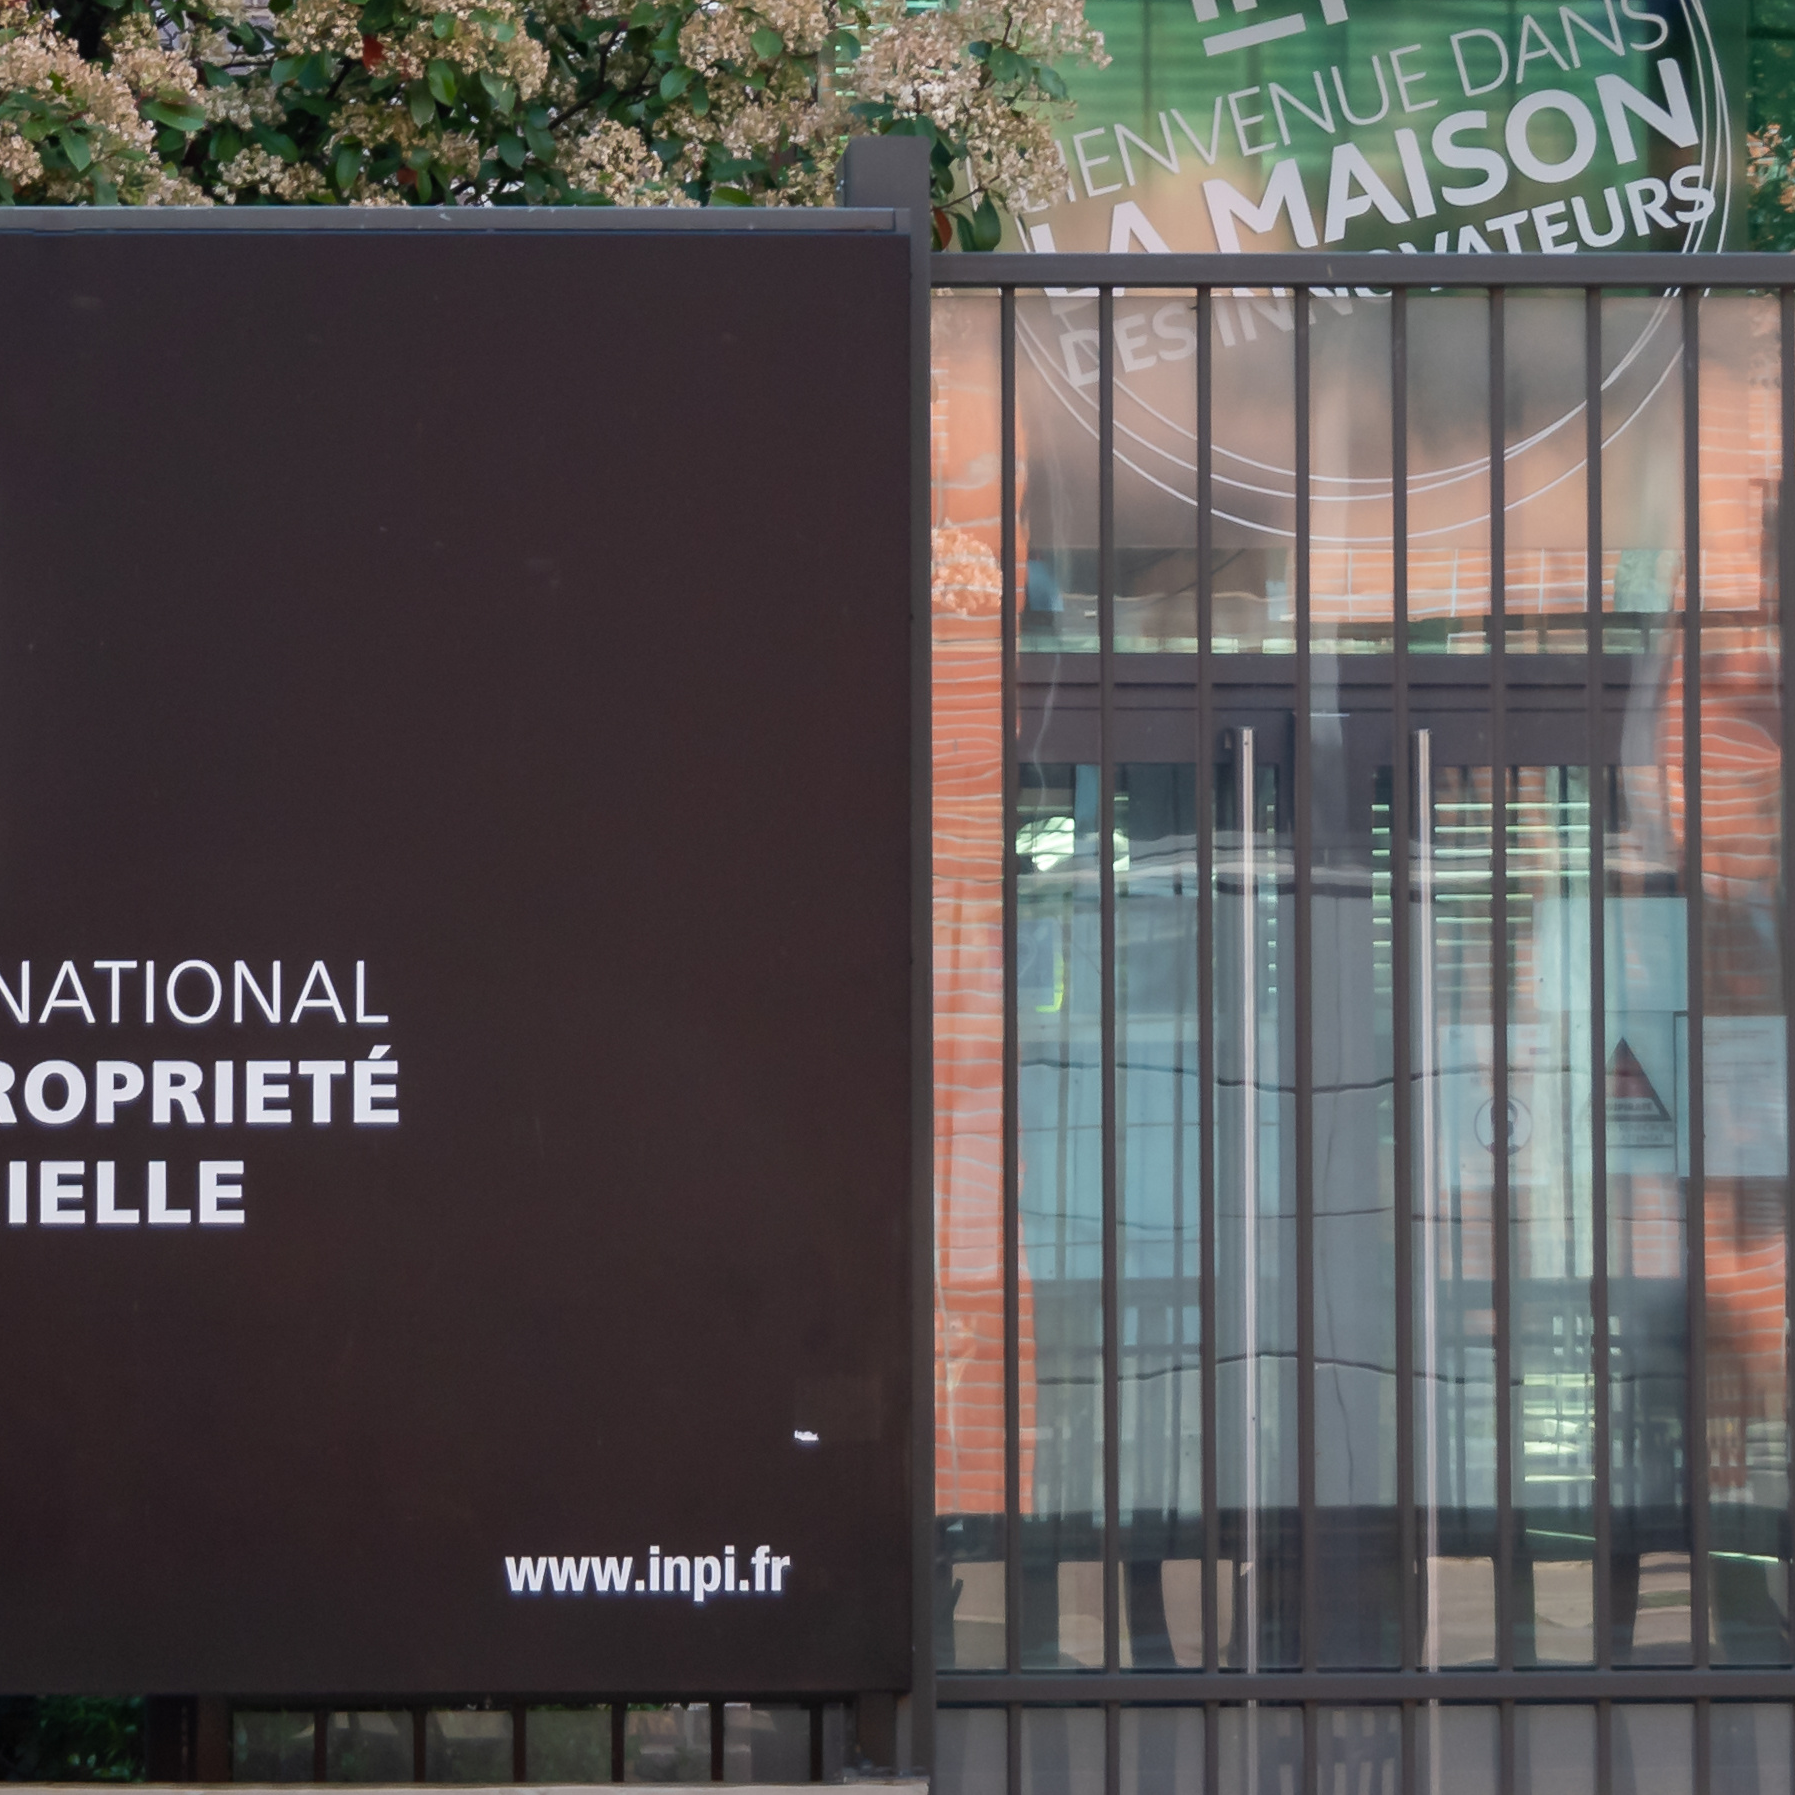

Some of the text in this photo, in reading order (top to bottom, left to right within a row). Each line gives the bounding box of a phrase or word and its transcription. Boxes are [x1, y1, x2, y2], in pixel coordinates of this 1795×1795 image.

[1022, 44, 1439, 212] IENVENUE
[1203, 57, 1700, 254] MAISON
[504, 1544, 791, 1603] www.inpi.fr
